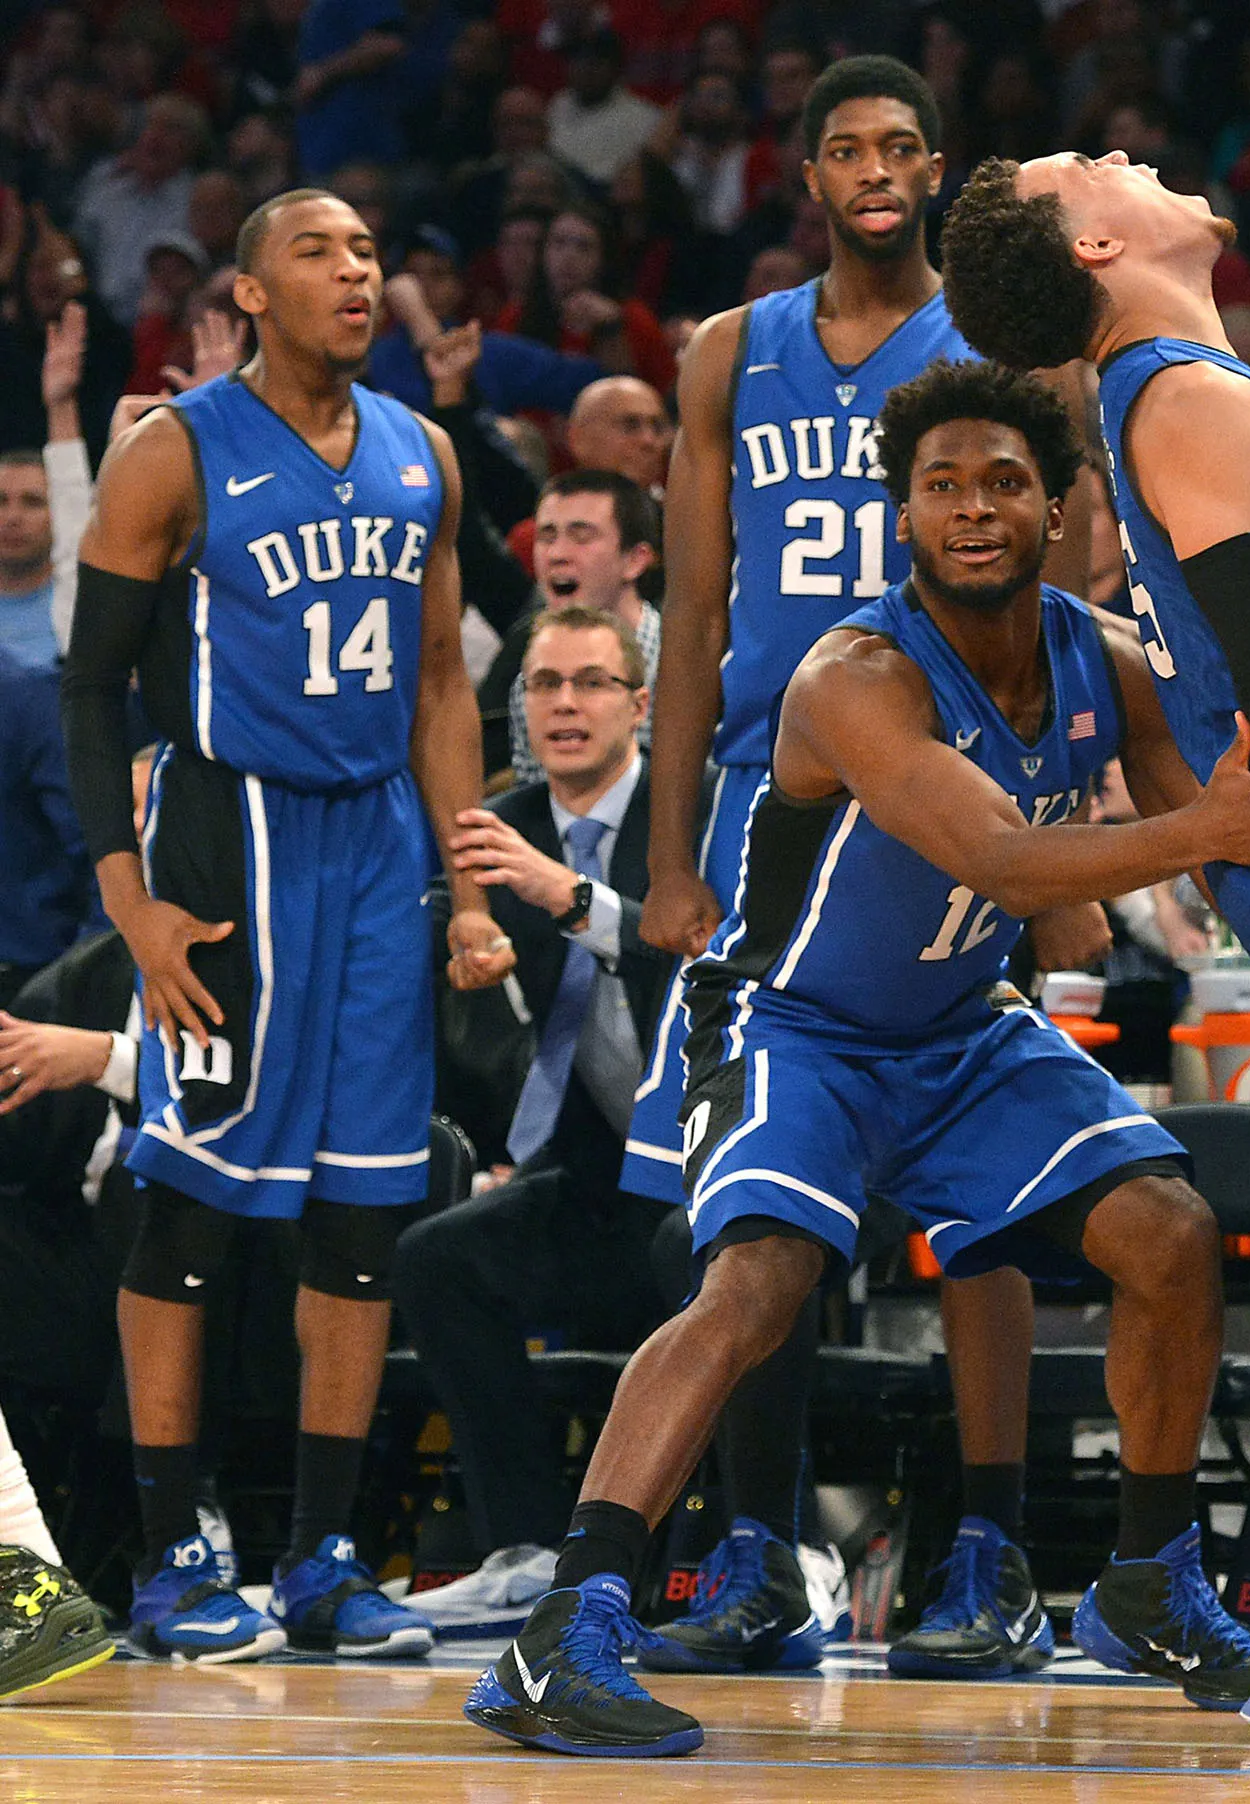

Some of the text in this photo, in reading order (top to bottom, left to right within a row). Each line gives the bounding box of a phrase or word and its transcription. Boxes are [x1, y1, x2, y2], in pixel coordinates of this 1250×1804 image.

[740, 415, 888, 490] DUK
[246, 516, 428, 599] DUKE
[780, 498, 890, 598] 21
[302, 597, 394, 696] 14
[178, 1030, 232, 1085] D
